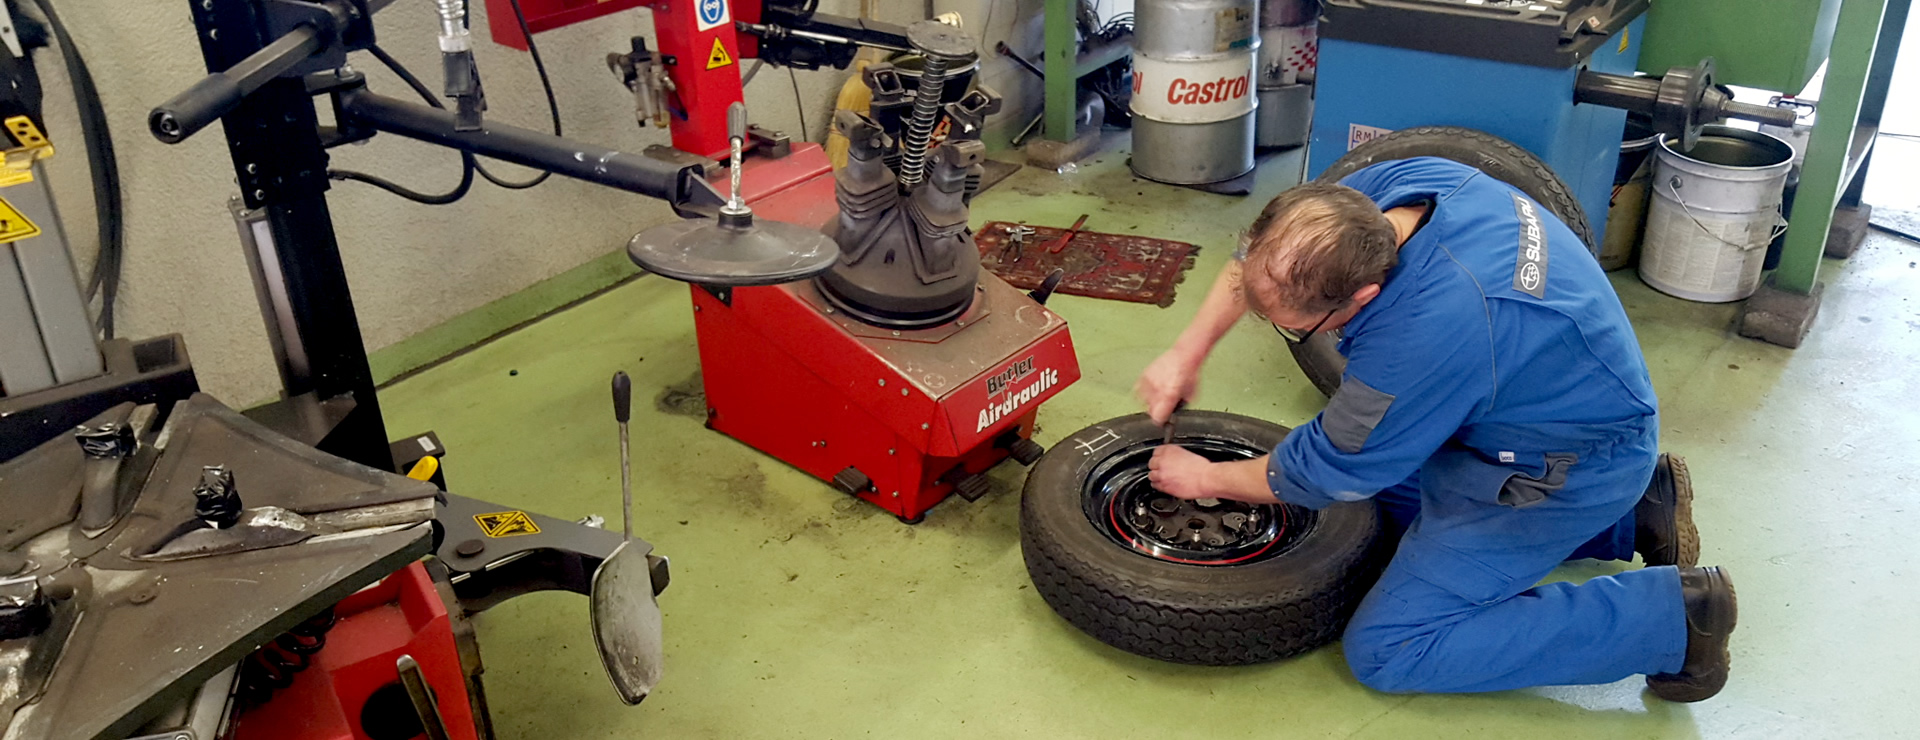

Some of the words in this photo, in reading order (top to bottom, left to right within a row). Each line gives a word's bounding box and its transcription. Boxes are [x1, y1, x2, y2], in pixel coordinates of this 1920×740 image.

[1167, 70, 1251, 105] Castrol
[1517, 196, 1541, 262] SUBARU
[976, 367, 1058, 433] Airdraulic
[986, 355, 1036, 396] Butler
